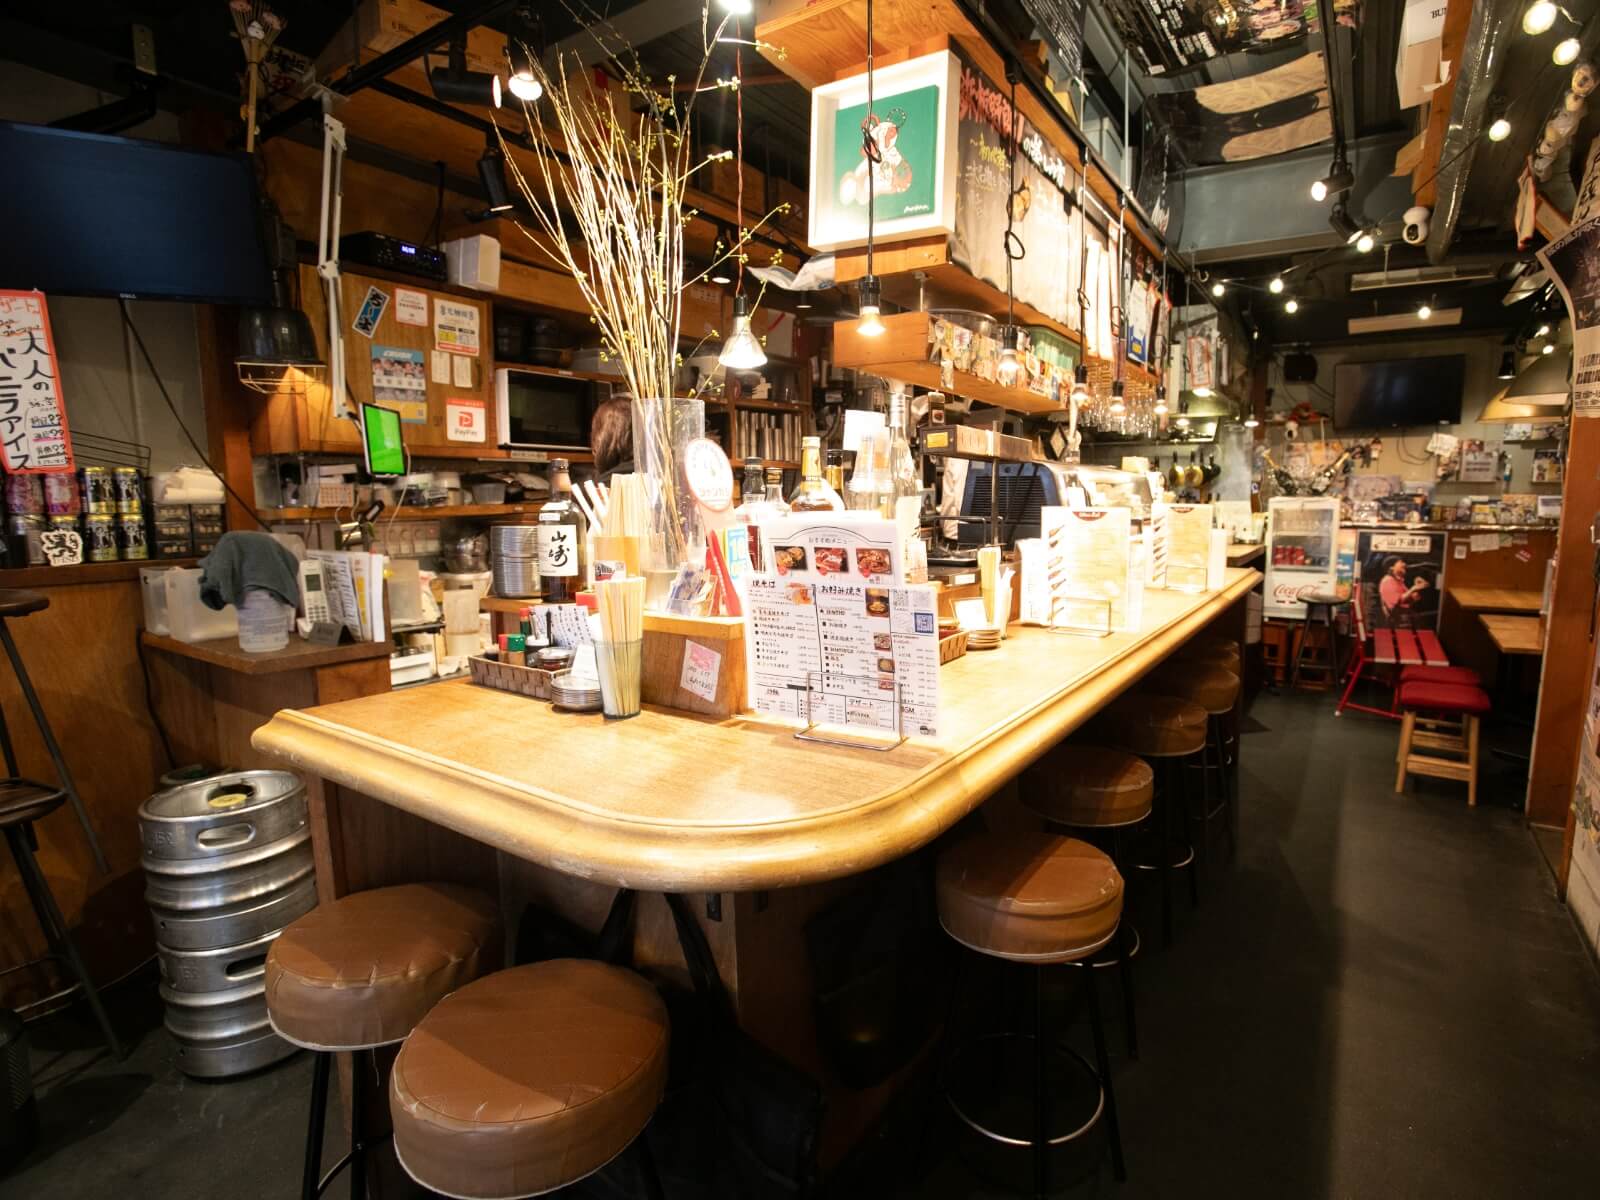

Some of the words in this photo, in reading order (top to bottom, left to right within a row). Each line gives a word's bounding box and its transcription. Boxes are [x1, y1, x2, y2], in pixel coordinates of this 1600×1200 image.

[820, 585, 863, 597] お好み焼き
